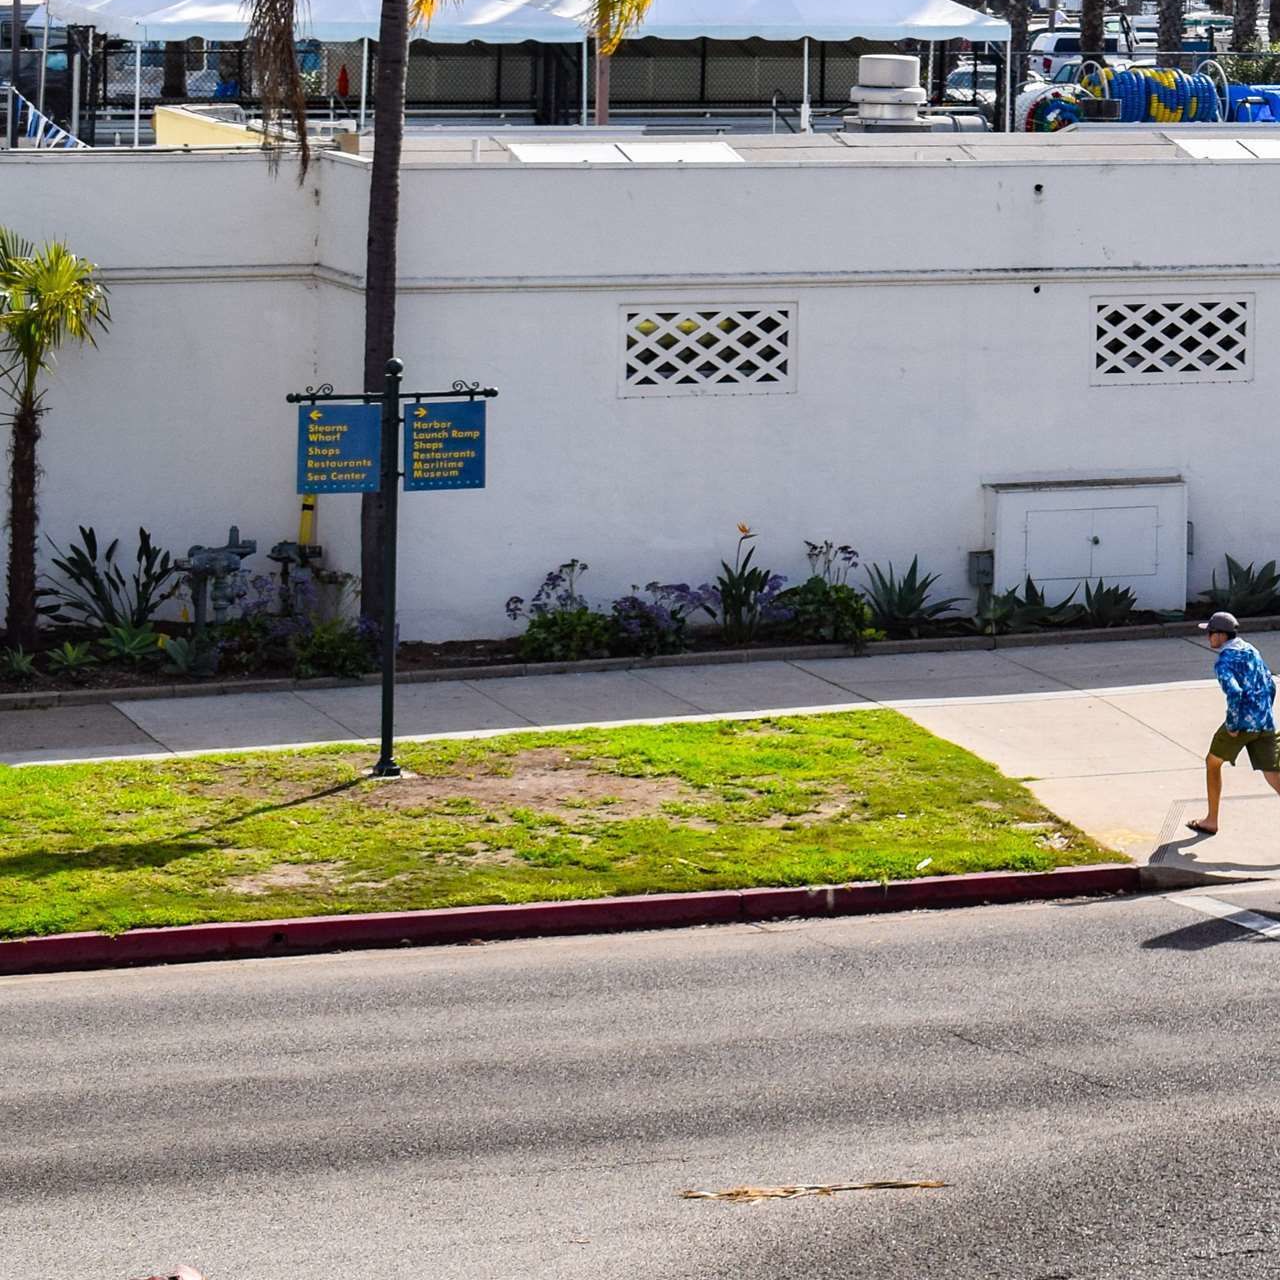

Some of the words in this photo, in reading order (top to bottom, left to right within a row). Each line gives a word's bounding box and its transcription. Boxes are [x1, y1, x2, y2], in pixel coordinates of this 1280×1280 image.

[308, 424, 348, 433] Stearns
[413, 421, 452, 429] Harbor
[308, 432, 341, 442] Wharf
[413, 430, 449, 440] Launch
[451, 430, 480, 439] Ramp
[413, 441, 443, 450] Shops
[308, 447, 341, 457] Shops
[413, 450, 475, 459] Restaurants
[307, 459, 373, 468] Restaurants
[413, 460, 464, 469] Maritime
[307, 472, 327, 481] Sea
[331, 472, 367, 481] Center
[413, 469, 459, 478] Museum
